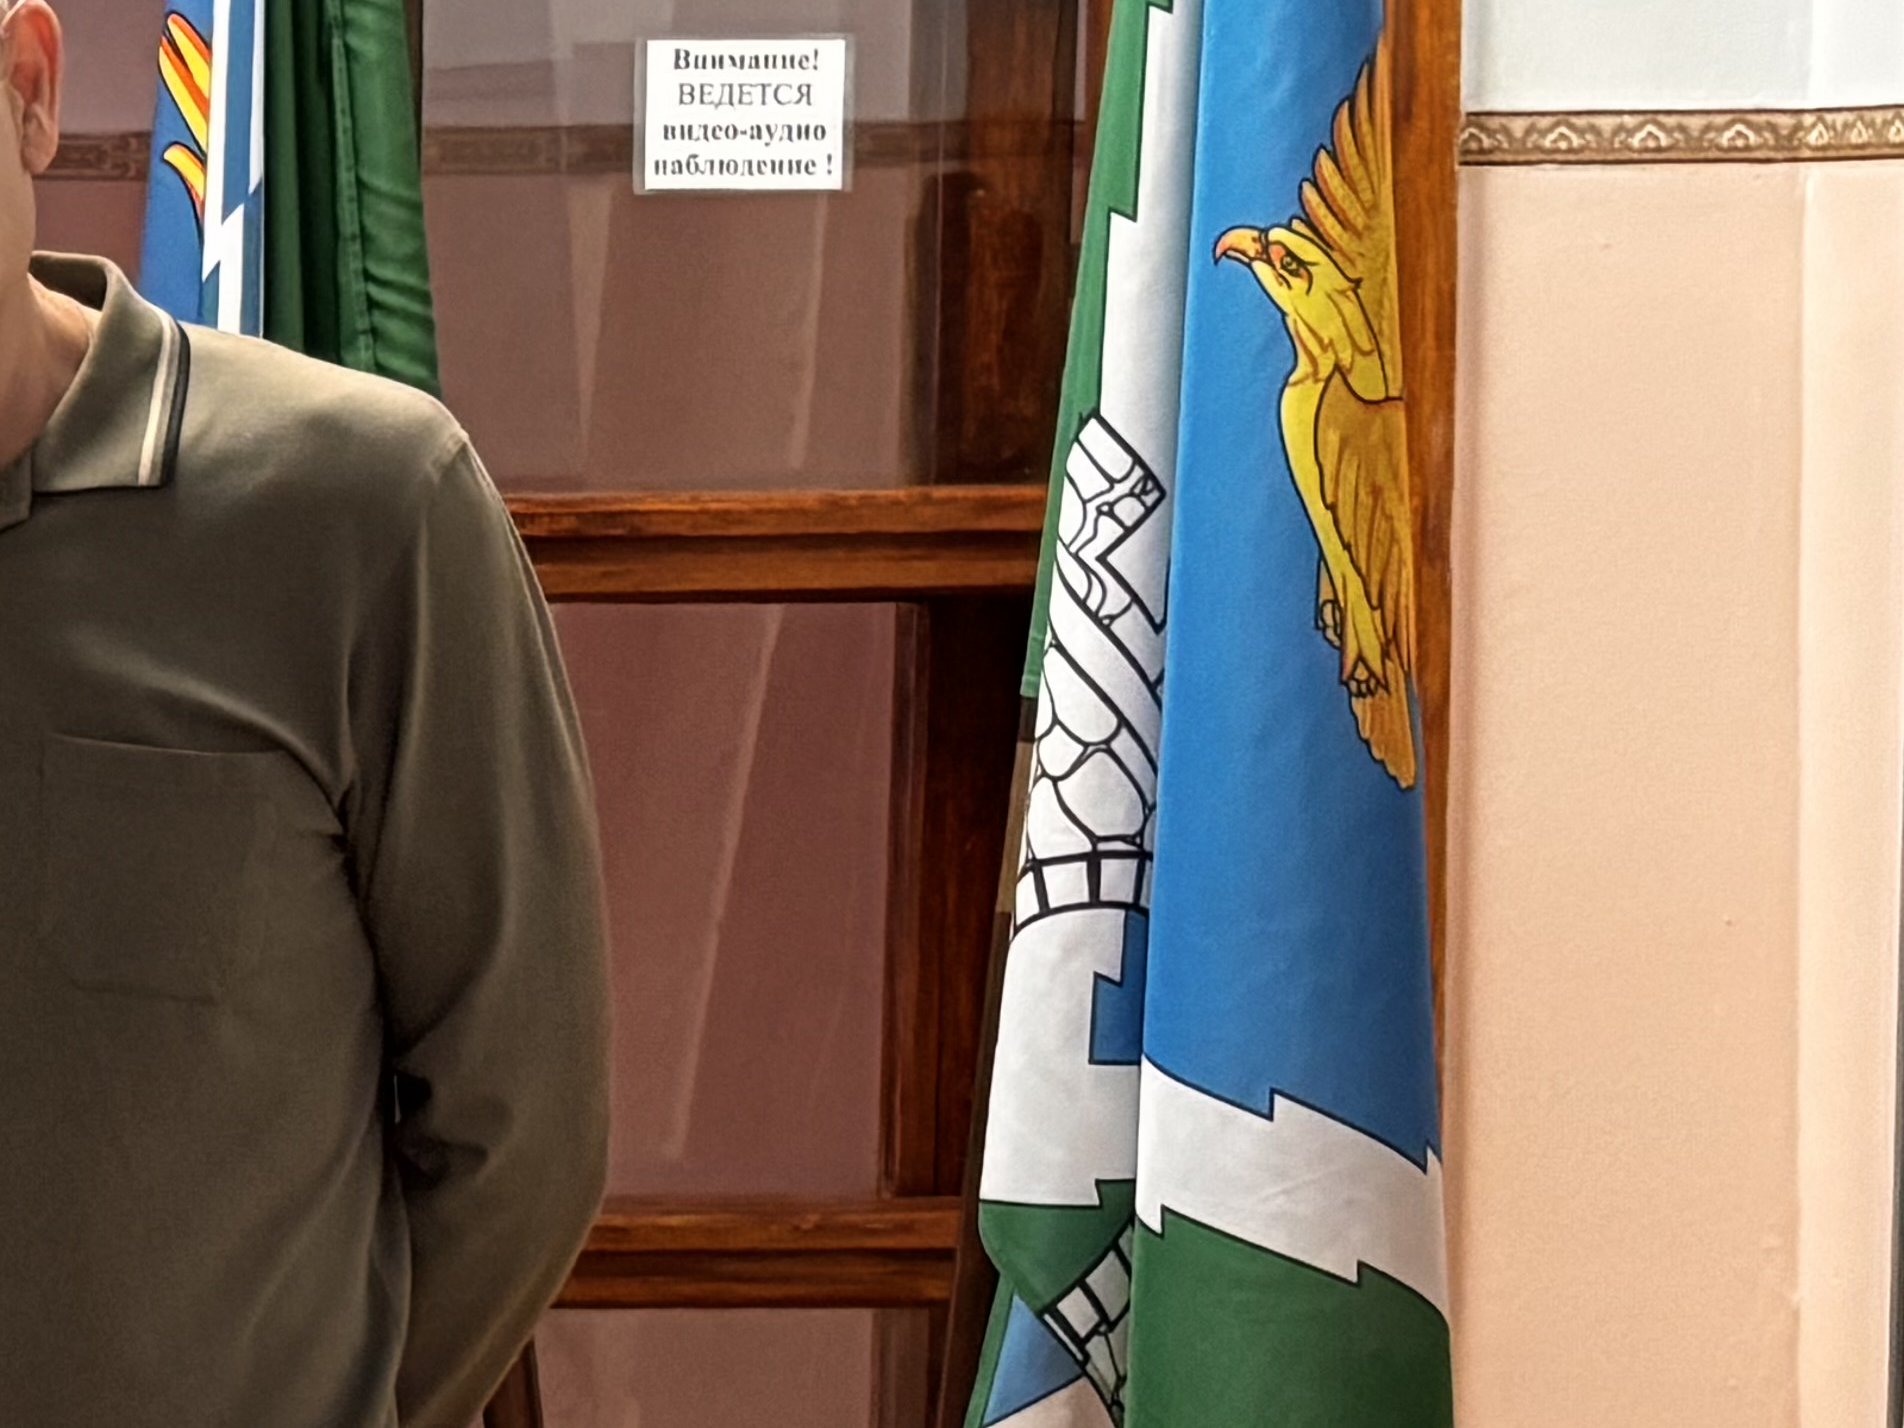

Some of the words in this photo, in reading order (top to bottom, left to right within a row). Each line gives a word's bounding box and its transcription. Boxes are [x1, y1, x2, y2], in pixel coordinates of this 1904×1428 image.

[672, 47, 819, 71] Внимание!
[678, 82, 813, 110] ВЕДЕТСЯ
[662, 123, 827, 147] видео-аудио
